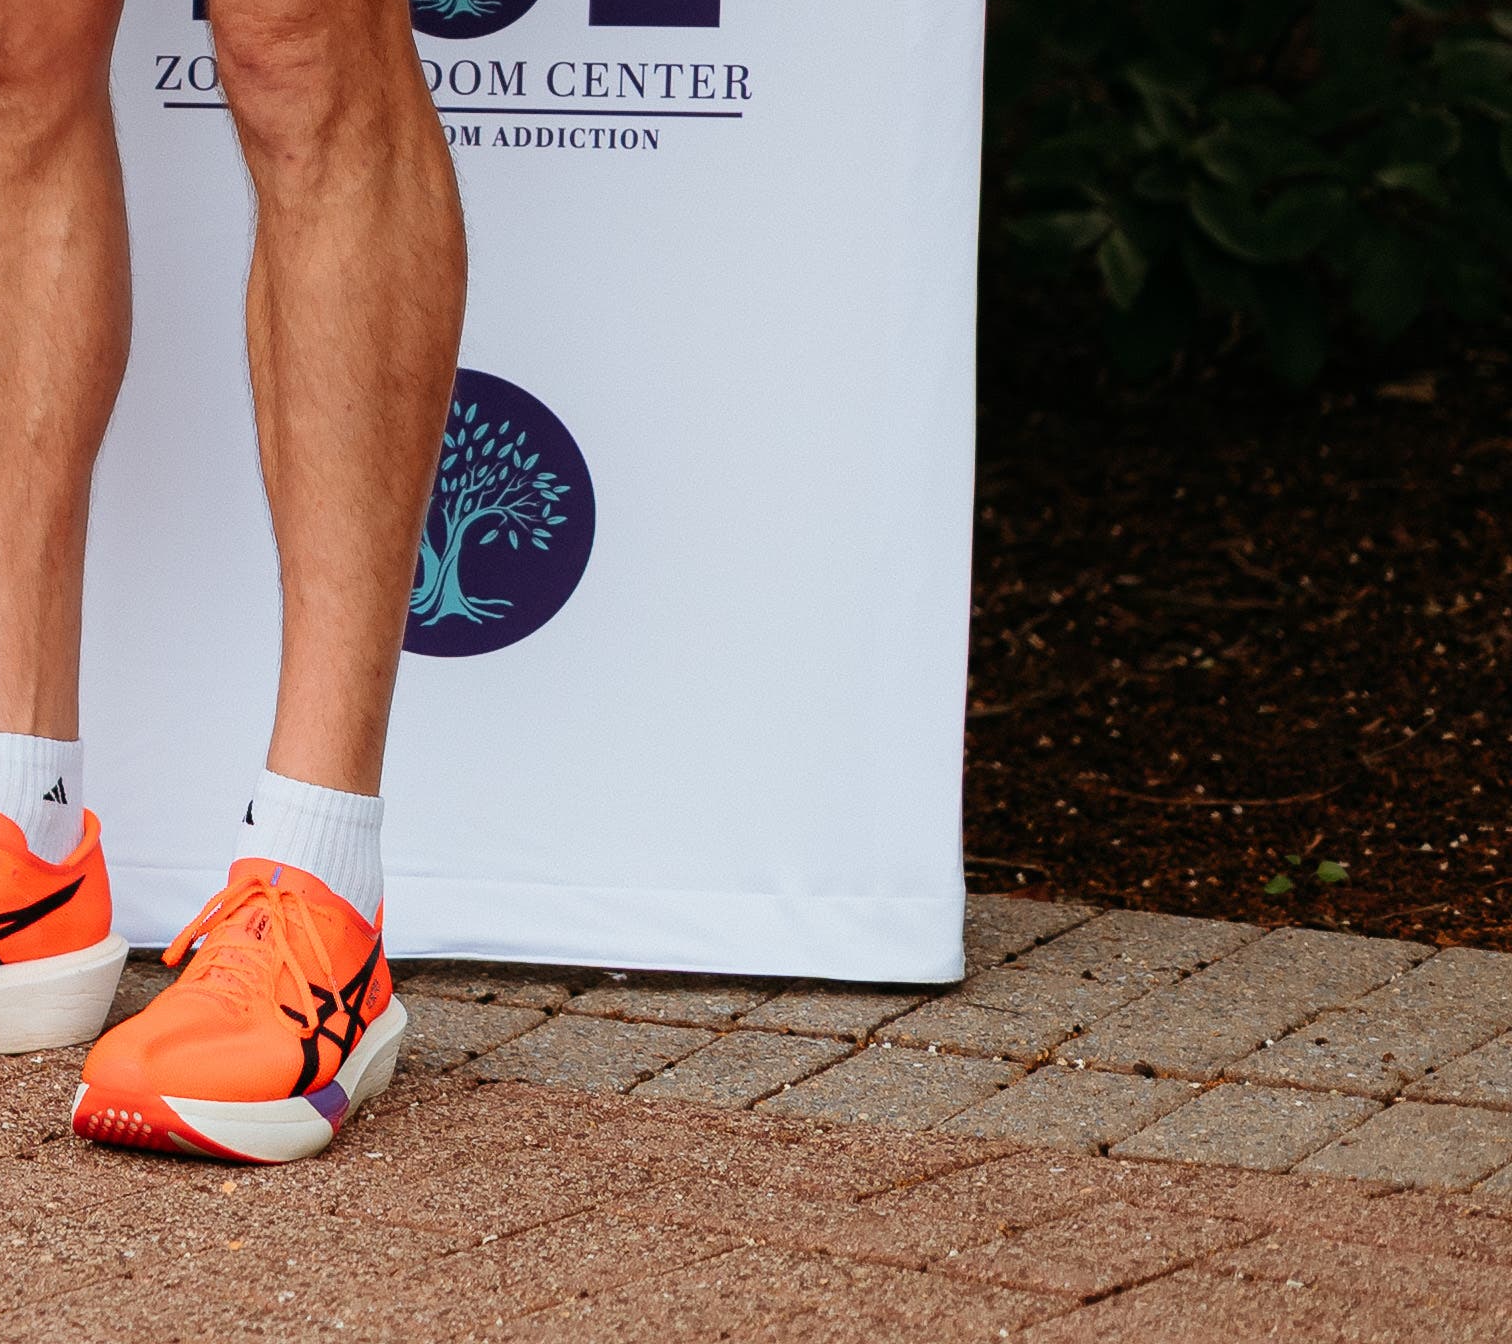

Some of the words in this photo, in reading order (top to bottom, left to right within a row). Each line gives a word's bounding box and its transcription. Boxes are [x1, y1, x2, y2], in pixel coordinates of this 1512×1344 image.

[153, 54, 216, 93] ZO
[545, 60, 754, 101] CENTER
[490, 125, 660, 151] ADDICTION
